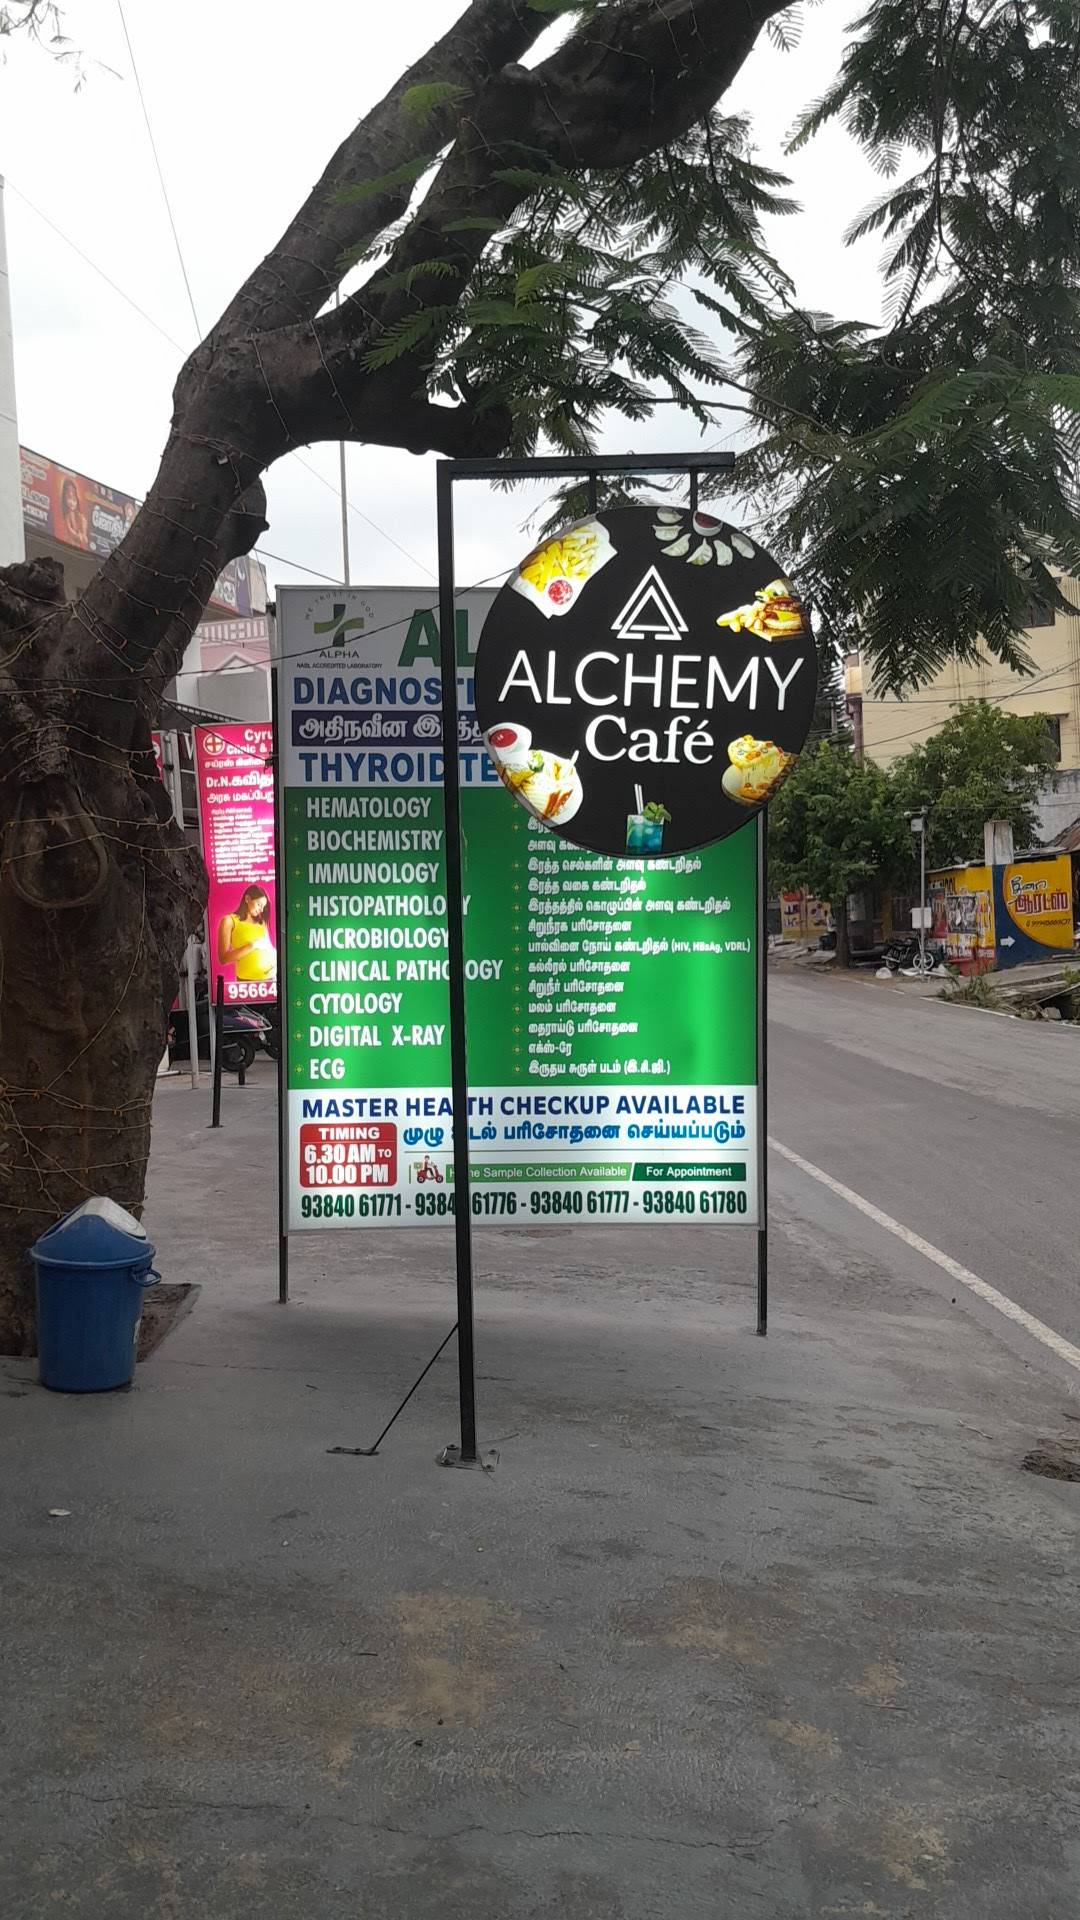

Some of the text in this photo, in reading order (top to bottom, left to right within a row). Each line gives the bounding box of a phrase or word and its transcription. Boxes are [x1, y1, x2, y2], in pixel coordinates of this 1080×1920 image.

[398, 609, 478, 667] AL
[319, 650, 360, 658] ALPHA
[498, 650, 804, 710] ALCHEMY
[294, 677, 475, 705] DIAGNOSI
[245, 729, 273, 743] Cyru
[299, 713, 408, 744] அதிநவீன
[226, 744, 256, 755] Clinic
[585, 714, 714, 765] Café
[299, 753, 499, 782] THYROID TE
[306, 797, 432, 818] HEMATOLOGY
[307, 830, 444, 851] BIOCHEMISTRY
[308, 863, 440, 884] IMMUNOLOGY
[308, 895, 471, 916] HISTOPATHOLOY
[308, 928, 449, 949] MICROBIOLOGY
[309, 960, 503, 981] CLINICAL PATHOOGY
[228, 983, 277, 999] 95664
[309, 993, 402, 1014] CYTOLOGY
[309, 1025, 445, 1047] DIGITAL X-RAY
[310, 1058, 345, 1079] ECG
[302, 1095, 745, 1118] MASTER HEATH CHECKUP AVAILABLE
[318, 1127, 380, 1140] TIMING
[304, 1143, 392, 1164] 6.30 AM TO
[306, 1164, 389, 1184] 10.00 PM
[483, 1167, 523, 1180] Sample
[525, 1166, 577, 1177] Collection
[579, 1166, 627, 1177] Available
[646, 1166, 732, 1178] For Appointment
[301, 1195, 355, 1218] 93840
[358, 1193, 402, 1217] 61771
[415, 1193, 456, 1216] 9384
[472, 1192, 517, 1215] 61776
[530, 1191, 583, 1214] 93840
[587, 1191, 630, 1214] 61777
[643, 1191, 695, 1214] 93840
[700, 1190, 747, 1214] 61780
